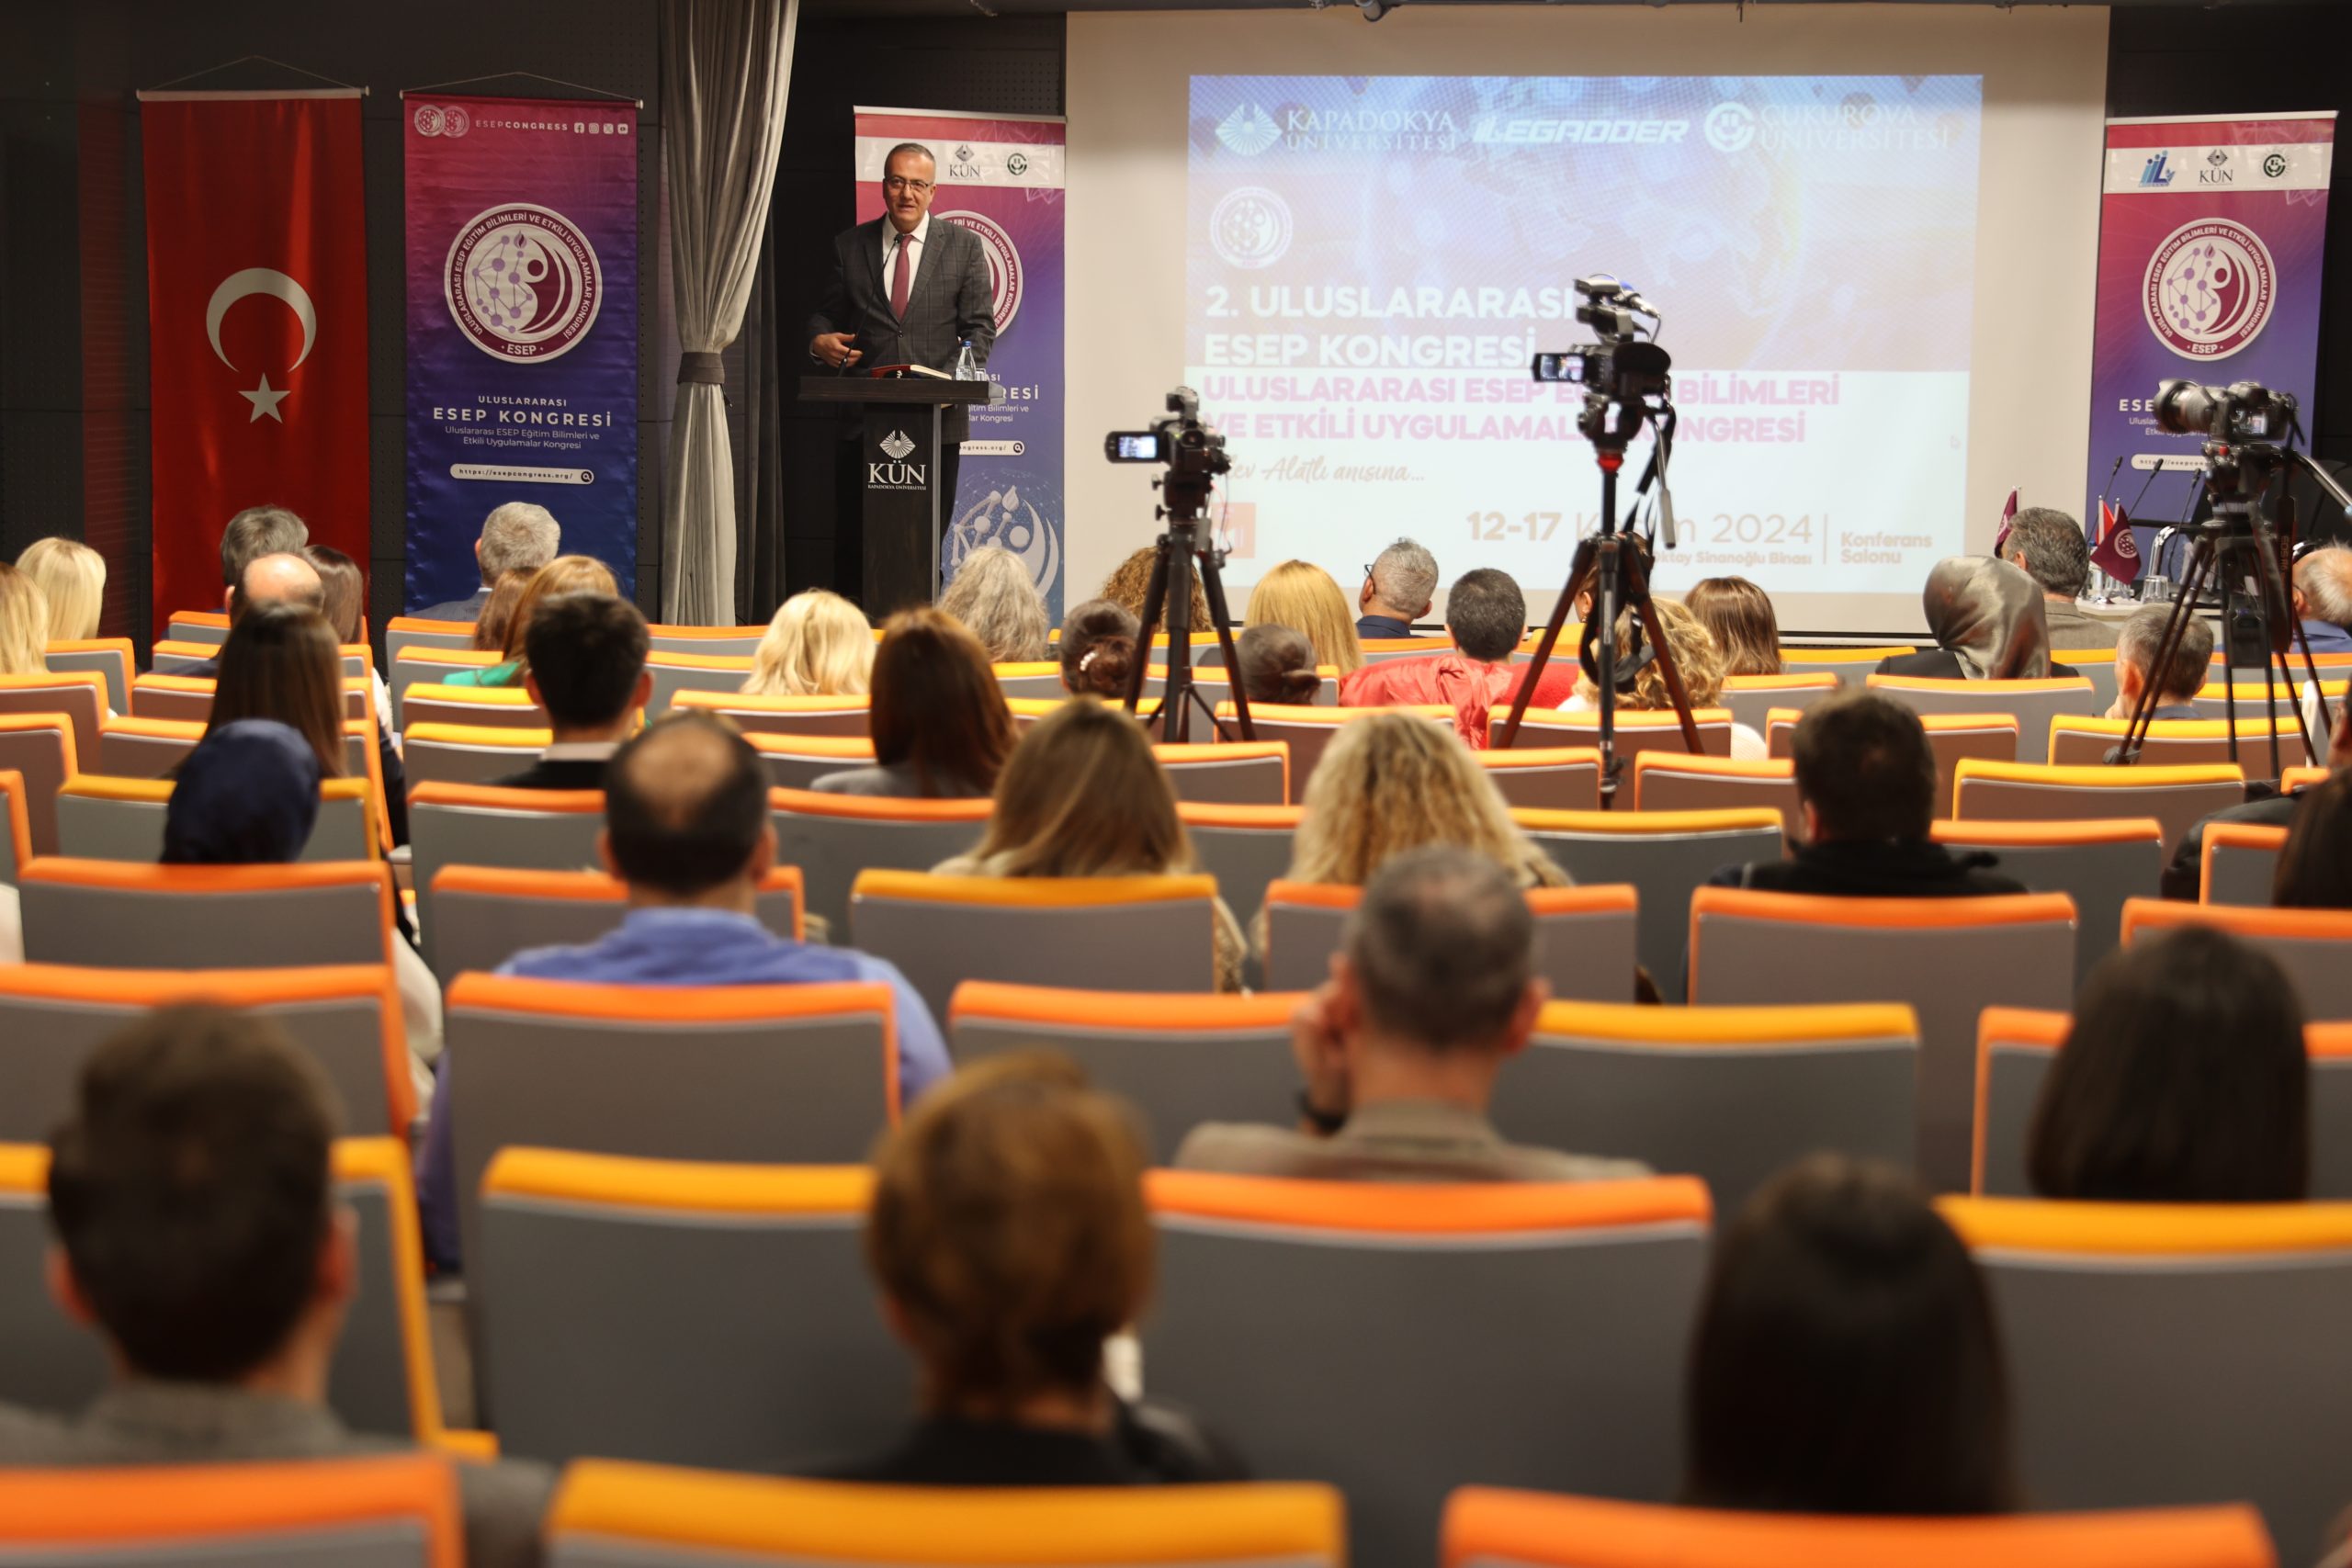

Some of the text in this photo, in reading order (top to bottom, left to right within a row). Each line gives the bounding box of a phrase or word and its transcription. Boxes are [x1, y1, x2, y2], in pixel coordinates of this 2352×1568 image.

[1287, 109, 1455, 132] KAPADOKYA
[949, 163, 980, 177] KÜN
[2199, 167, 2233, 183] KÜN
[486, 211, 526, 230] BİLİMLERİ
[529, 213, 540, 224] VE
[967, 220, 976, 229] VE
[541, 218, 568, 238] ETKİLİ
[2219, 228, 2228, 236] VE
[458, 251, 466, 273] ESEP
[566, 234, 593, 299] UYGULAMALAR
[454, 273, 483, 335] ULUSLARARASI
[1204, 286, 1575, 319] 2. ULUSLARARASI
[506, 344, 537, 355] ESEP
[1204, 327, 1536, 367] ESEP KONGRESİ
[2191, 344, 2218, 354] ESEP
[1203, 376, 1455, 403] ULUSLARARASI
[1464, 377, 1546, 403] ESEP
[1678, 373, 1839, 405] BİLİMLERİ
[479, 395, 567, 407] ULUSLARARASI
[988, 404, 1019, 412] Bilimleri
[2119, 399, 2154, 412] ESE
[433, 407, 611, 427] ESEP KONGRESİ
[980, 414, 1013, 423] Kongresi
[1255, 407, 1355, 440] ETKİLİ
[1362, 412, 1622, 441] UYGULAMAL
[445, 425, 495, 436] Uluslararası
[496, 428, 519, 436] ESEP
[521, 429, 550, 439] Eğitim
[552, 430, 588, 440] Bilimleri
[463, 437, 582, 450] Etkili Uygulamalar Kongresi
[867, 459, 927, 484] KÜN
[1466, 511, 1562, 541] 12-17
[1712, 513, 1813, 545] 2024
[1840, 532, 1933, 548] Konferans
[1695, 550, 1765, 568] Sinanoğlu
[1769, 551, 1813, 566] Binası
[1840, 549, 1902, 565] Salonu
